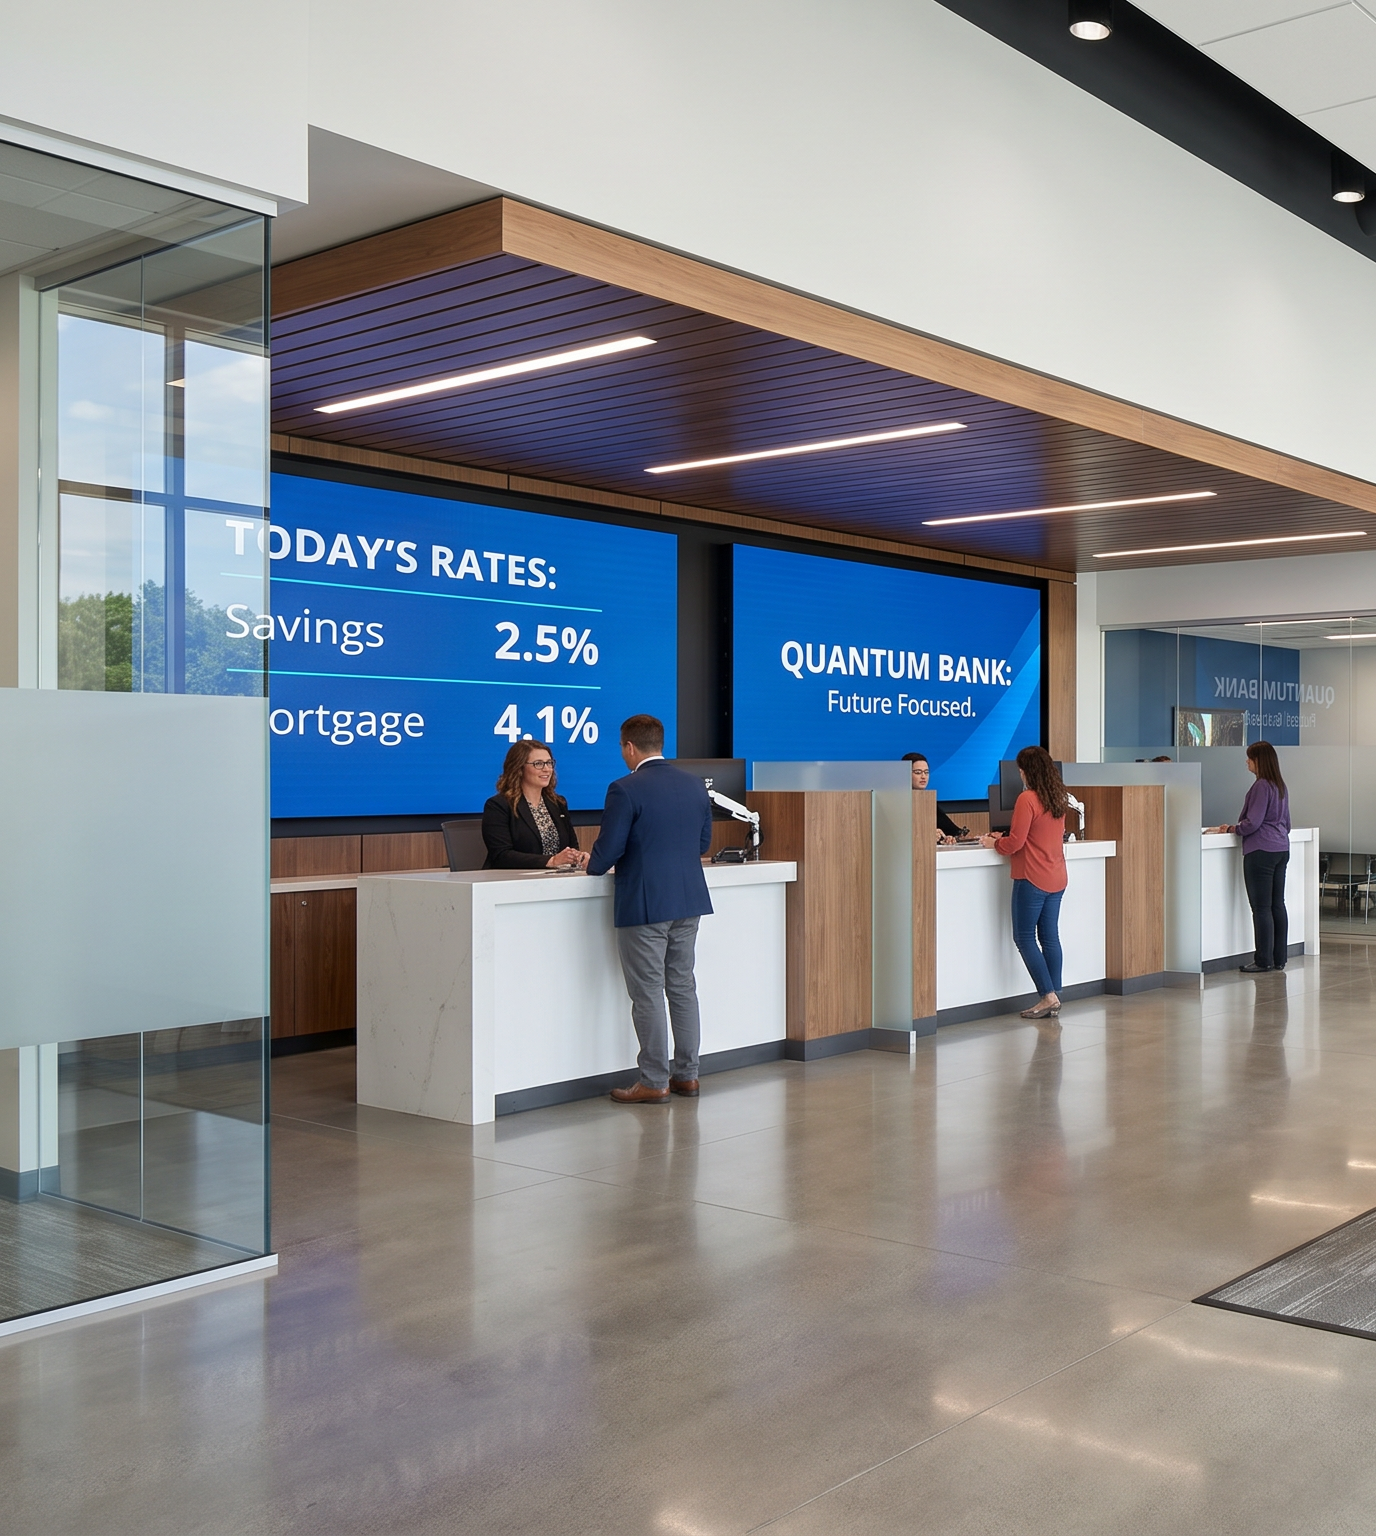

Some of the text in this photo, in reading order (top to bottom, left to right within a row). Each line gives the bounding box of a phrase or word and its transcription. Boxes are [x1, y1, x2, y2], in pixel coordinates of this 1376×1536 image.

[225, 518, 557, 590] TODAY’S RATES:
[225, 603, 599, 666] Savings 2.5%
[780, 640, 1012, 687] QUANTUM BANK:
[268, 704, 599, 746] ortgage 4.1%
[827, 689, 977, 718] Future Focused.
